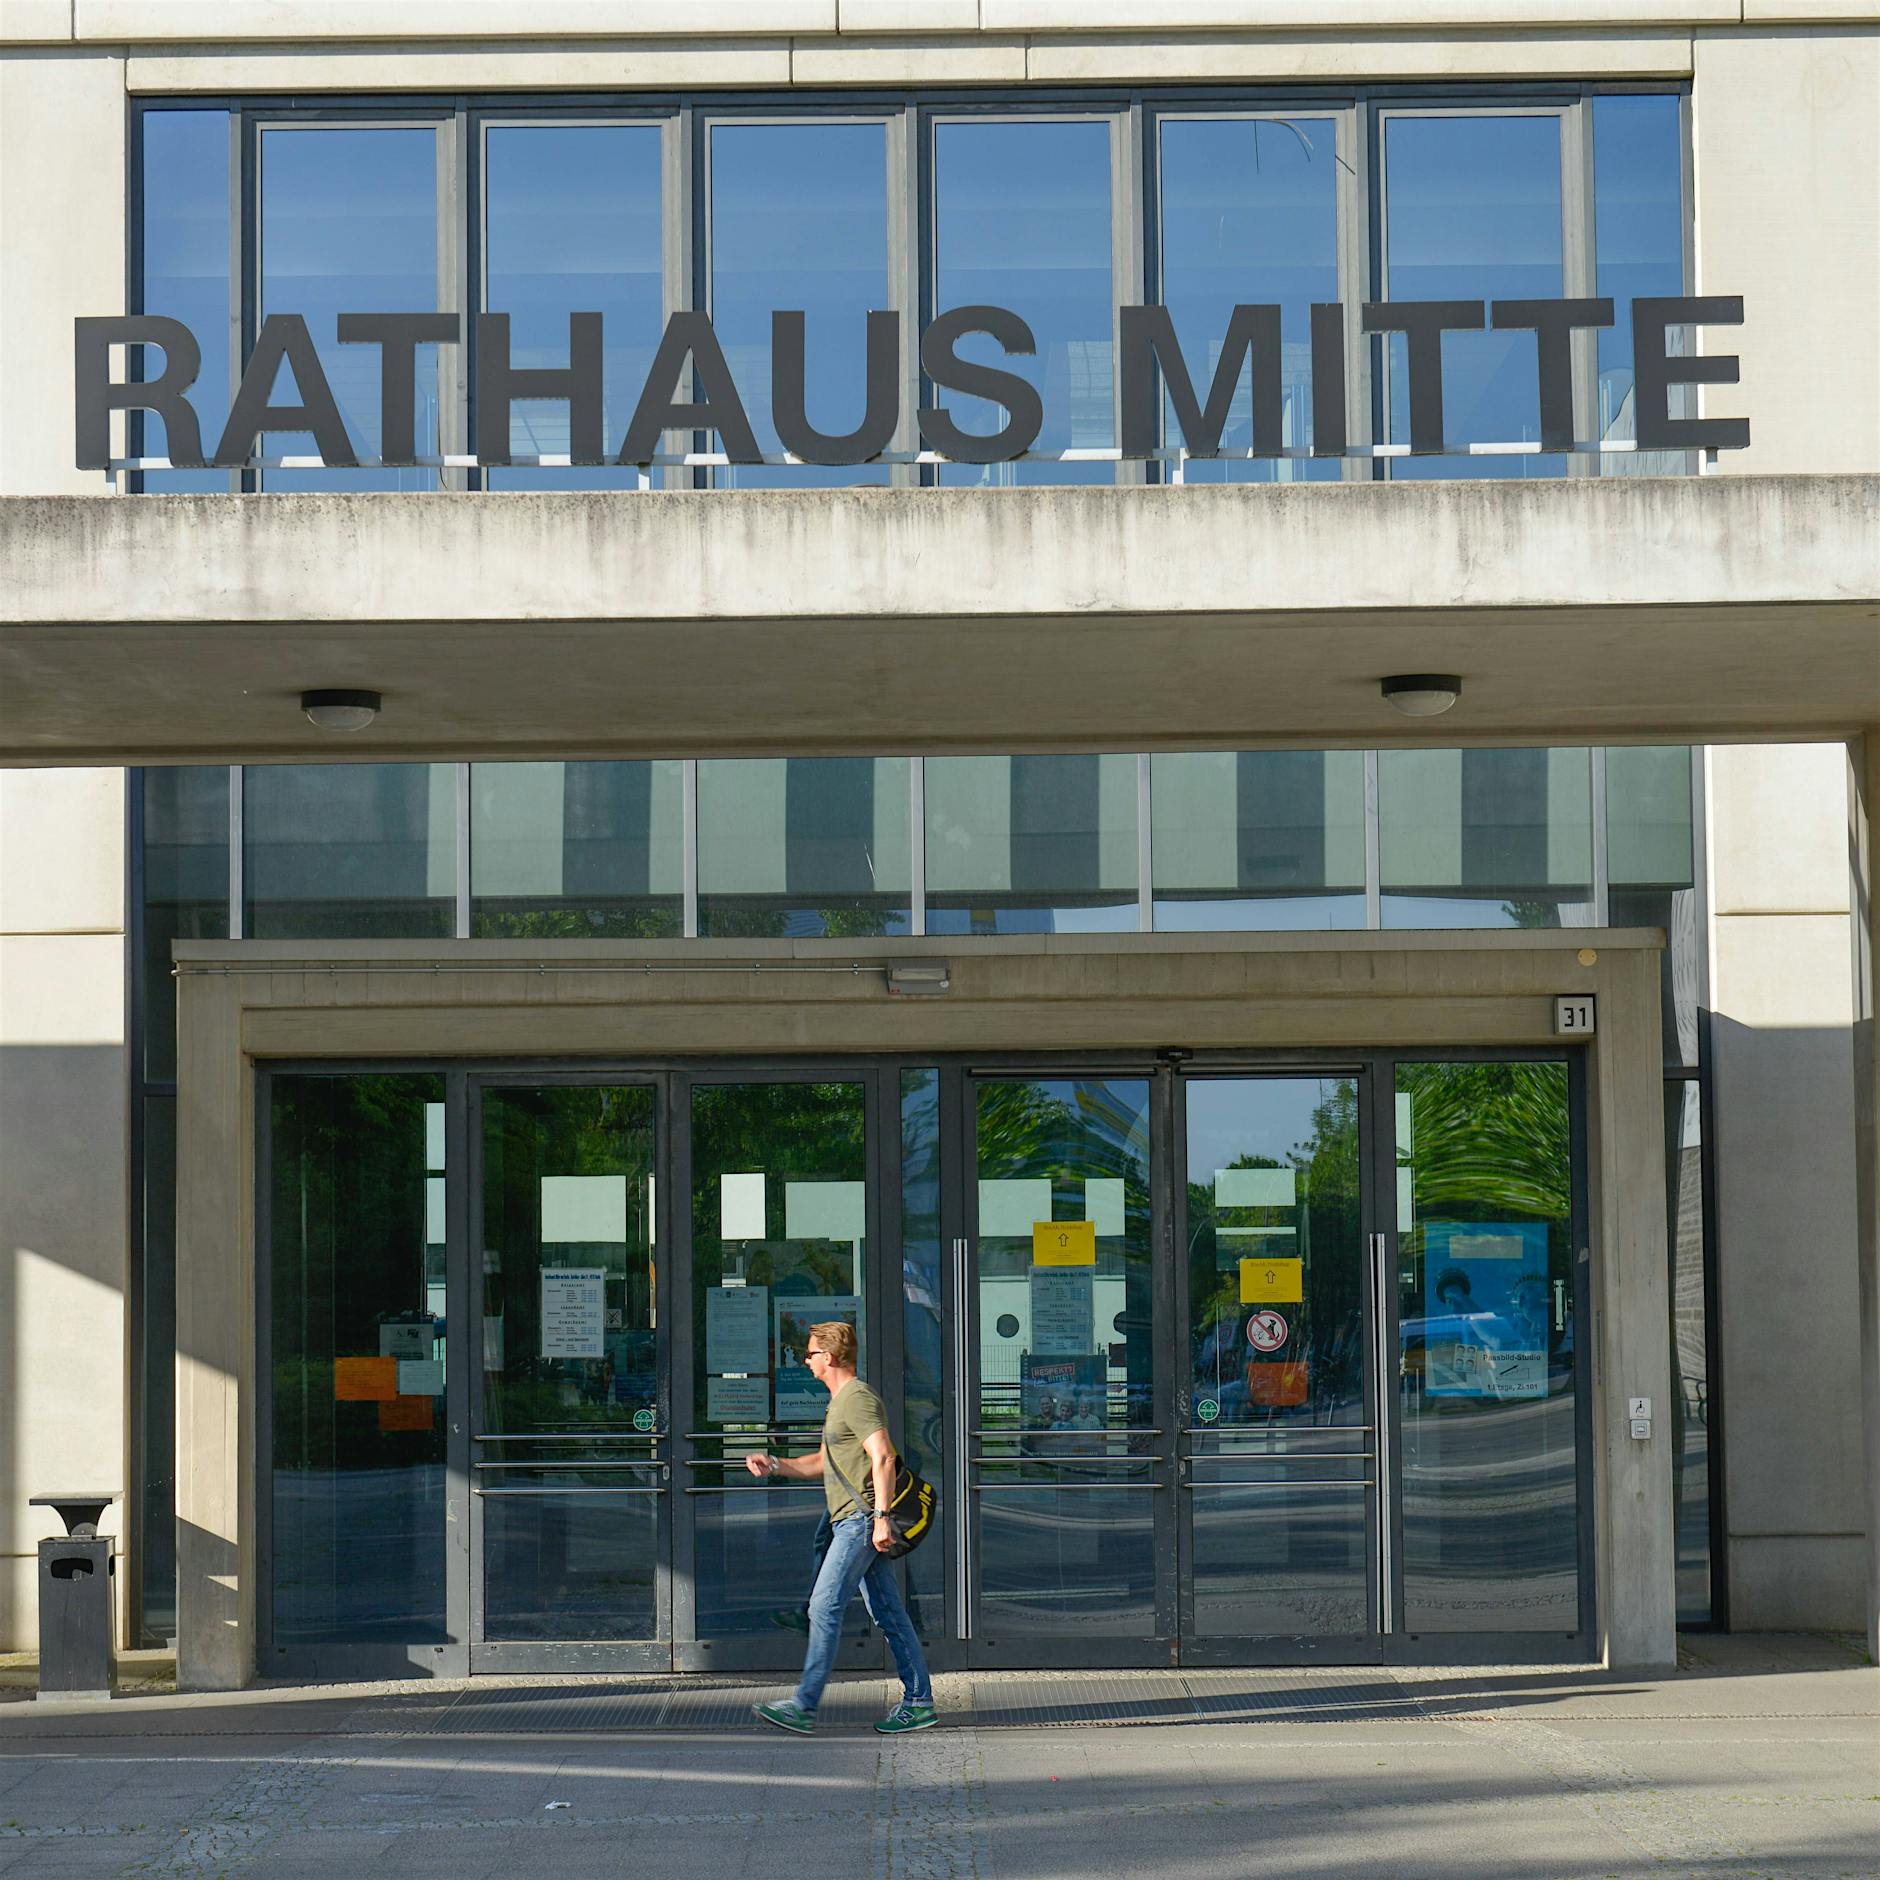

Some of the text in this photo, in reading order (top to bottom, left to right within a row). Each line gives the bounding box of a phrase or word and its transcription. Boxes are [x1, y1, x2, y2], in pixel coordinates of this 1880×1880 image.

[75, 296, 1751, 470] RATHAUS MITTE
[1564, 1007, 1586, 1027] 31
